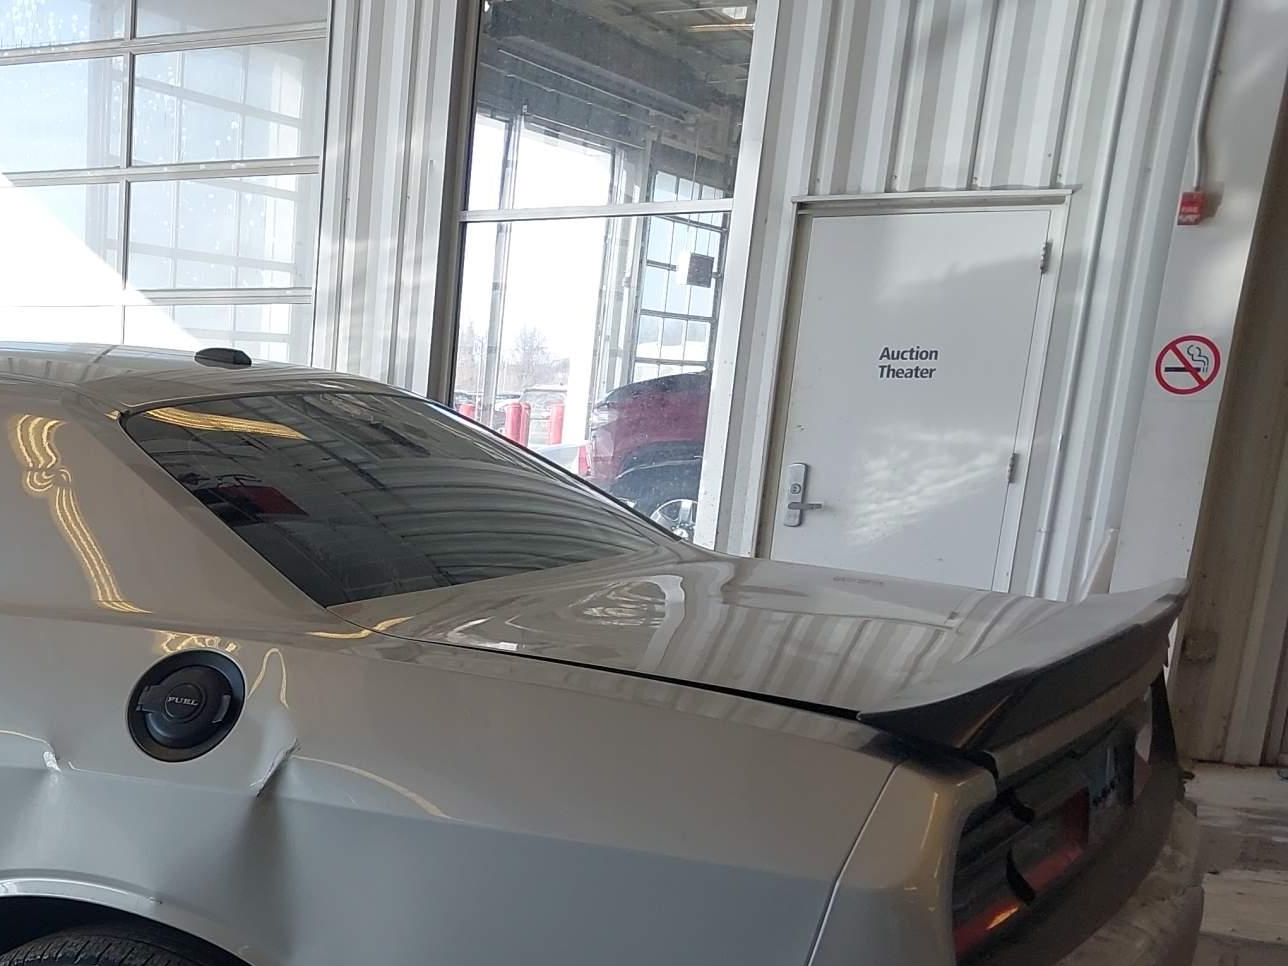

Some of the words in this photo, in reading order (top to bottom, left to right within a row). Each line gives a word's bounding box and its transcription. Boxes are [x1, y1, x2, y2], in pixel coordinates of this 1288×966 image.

[878, 345, 939, 361] Auction
[878, 364, 937, 379] Theater
[167, 696, 199, 707] FUEL
